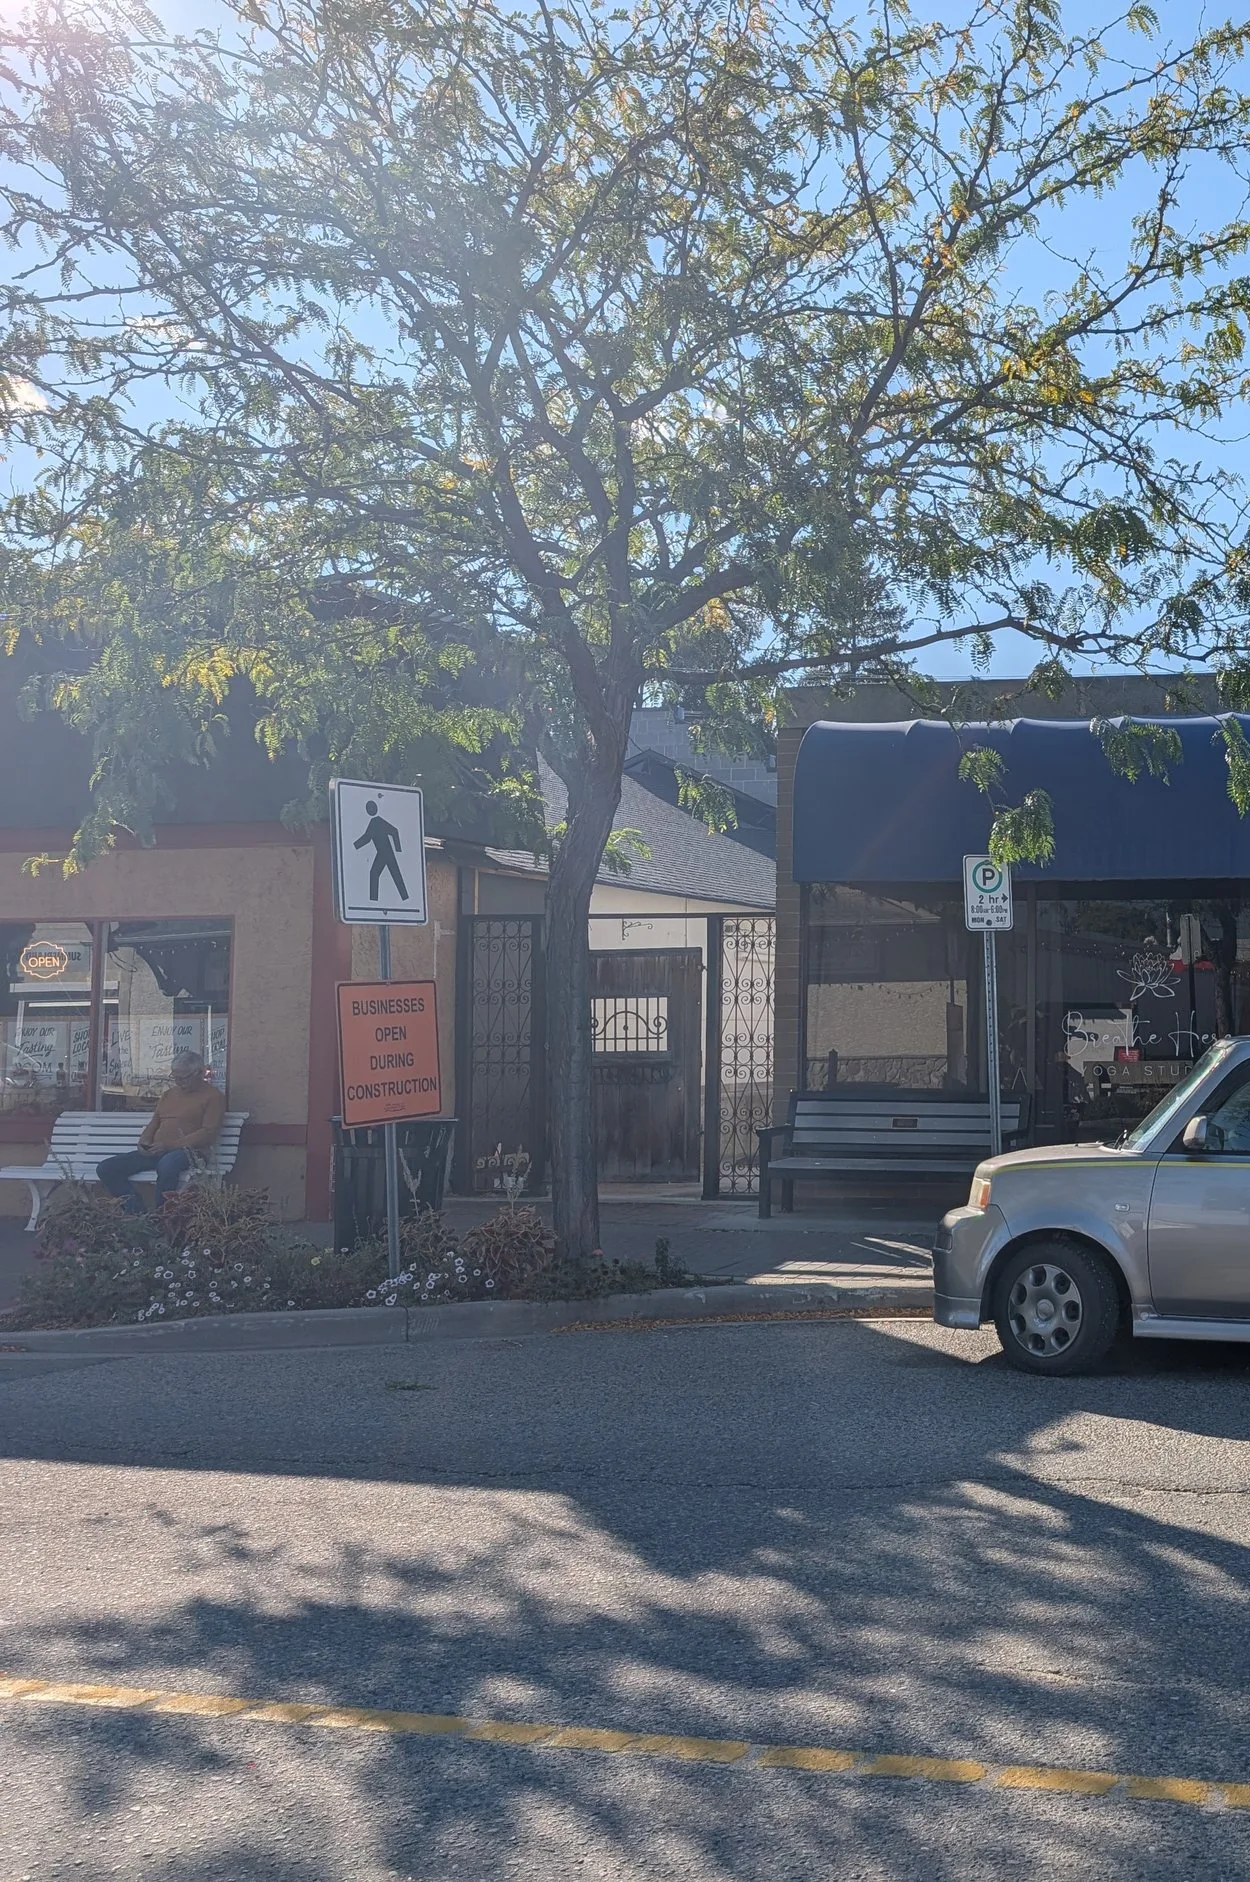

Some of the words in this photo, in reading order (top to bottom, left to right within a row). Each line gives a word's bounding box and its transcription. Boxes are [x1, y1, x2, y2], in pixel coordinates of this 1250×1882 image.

[982, 868, 995, 886] P
[978, 894, 984, 904] 2
[989, 895, 999, 904] hr
[971, 916, 985, 924] MON
[28, 956, 60, 967] OPEN
[352, 997, 425, 1016] BUSINESSES
[375, 1025, 407, 1042] OPEN
[1061, 1010, 1162, 1057] Breathe
[370, 1052, 414, 1070] DURING
[1081, 1065, 1131, 1077] YOGA
[347, 1076, 437, 1101] CONSTRUCTION
